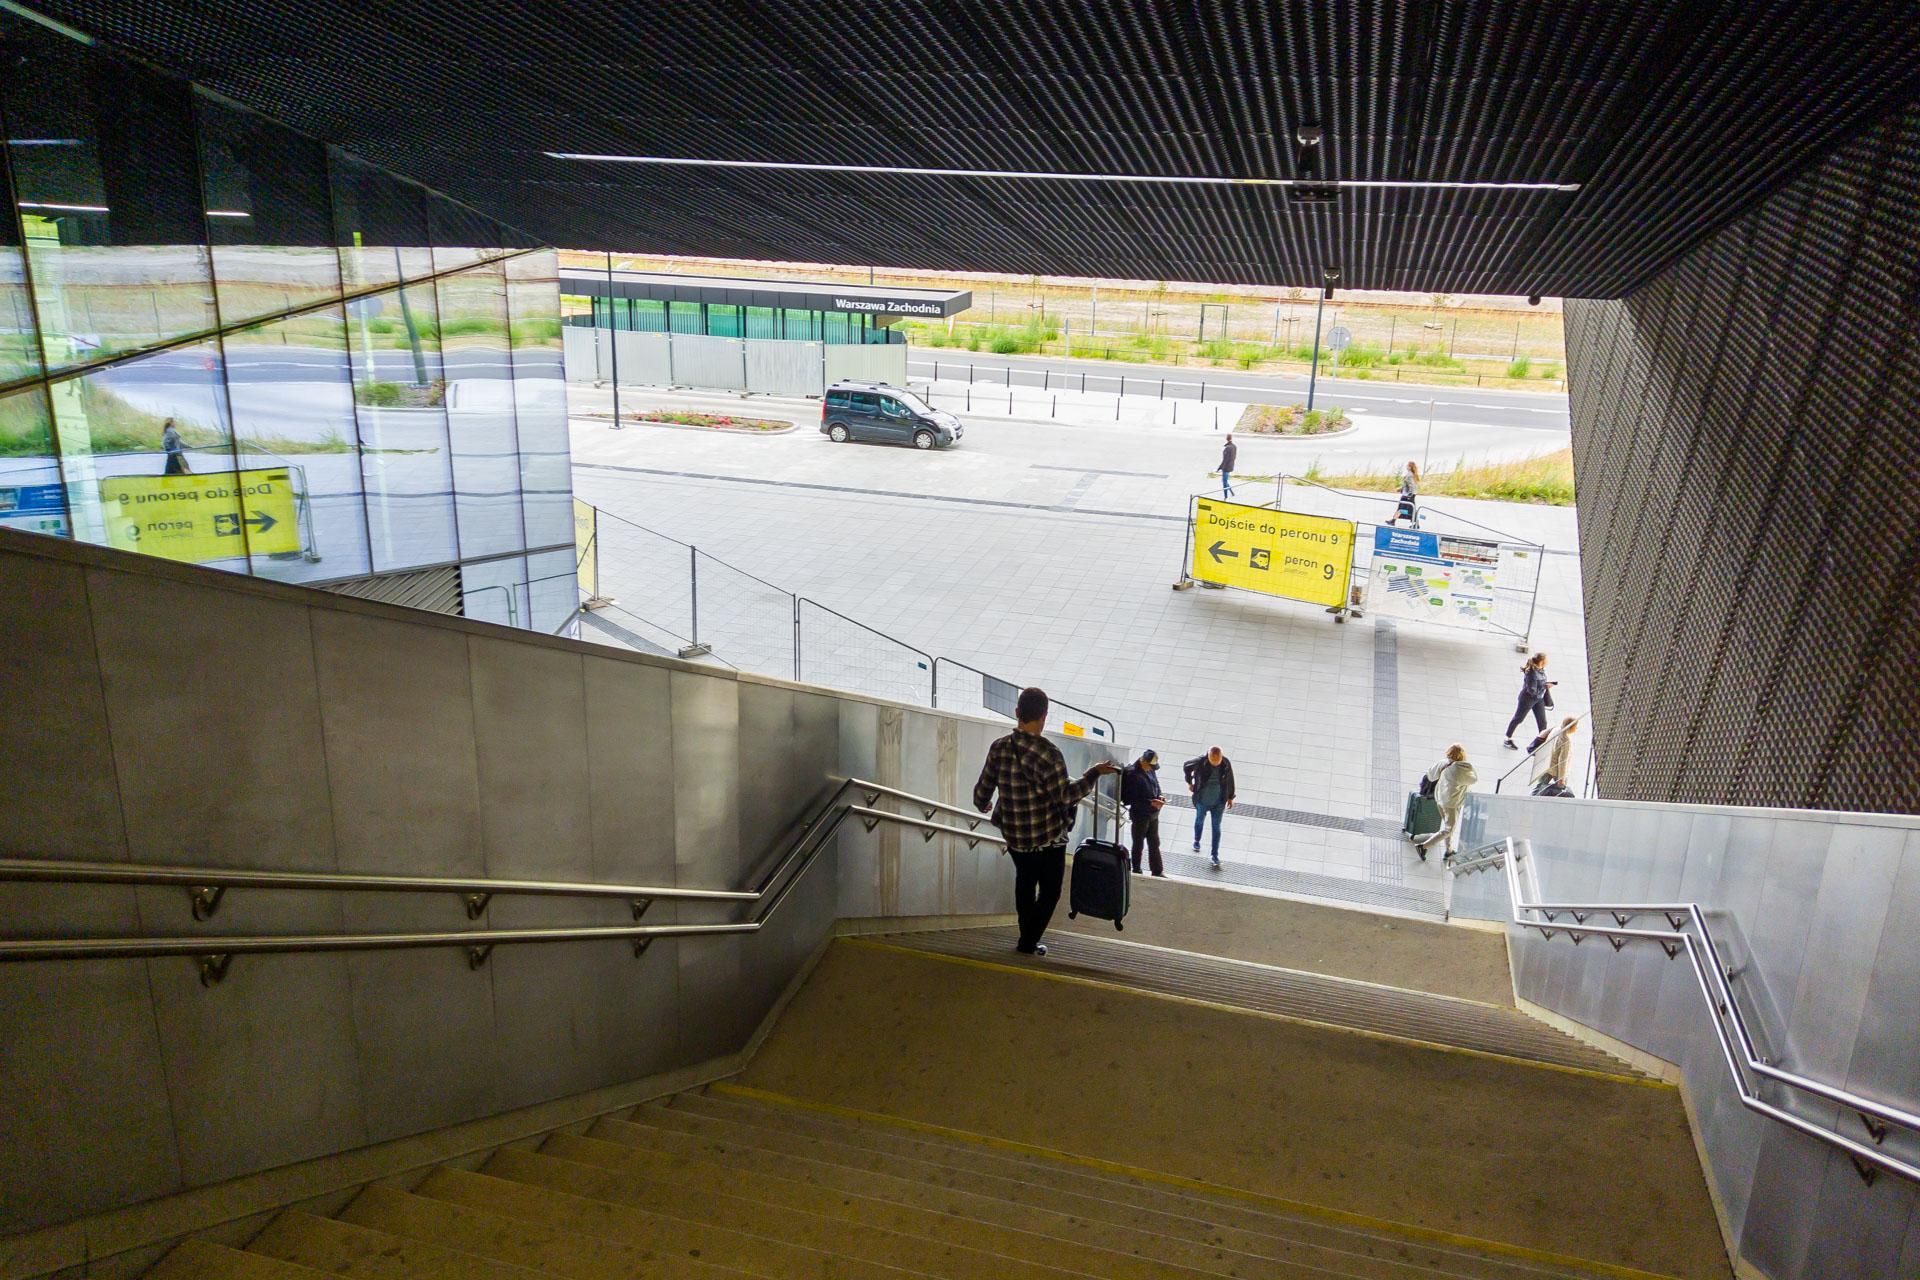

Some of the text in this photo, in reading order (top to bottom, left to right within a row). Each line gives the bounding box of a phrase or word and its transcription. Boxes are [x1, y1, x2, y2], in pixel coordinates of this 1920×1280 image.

[835, 298, 941, 314] Warszawa Zachodnia
[1208, 513, 1338, 545] Dojście do peronu 9
[1284, 555, 1318, 568] peron
[1323, 563, 1335, 580] 9
